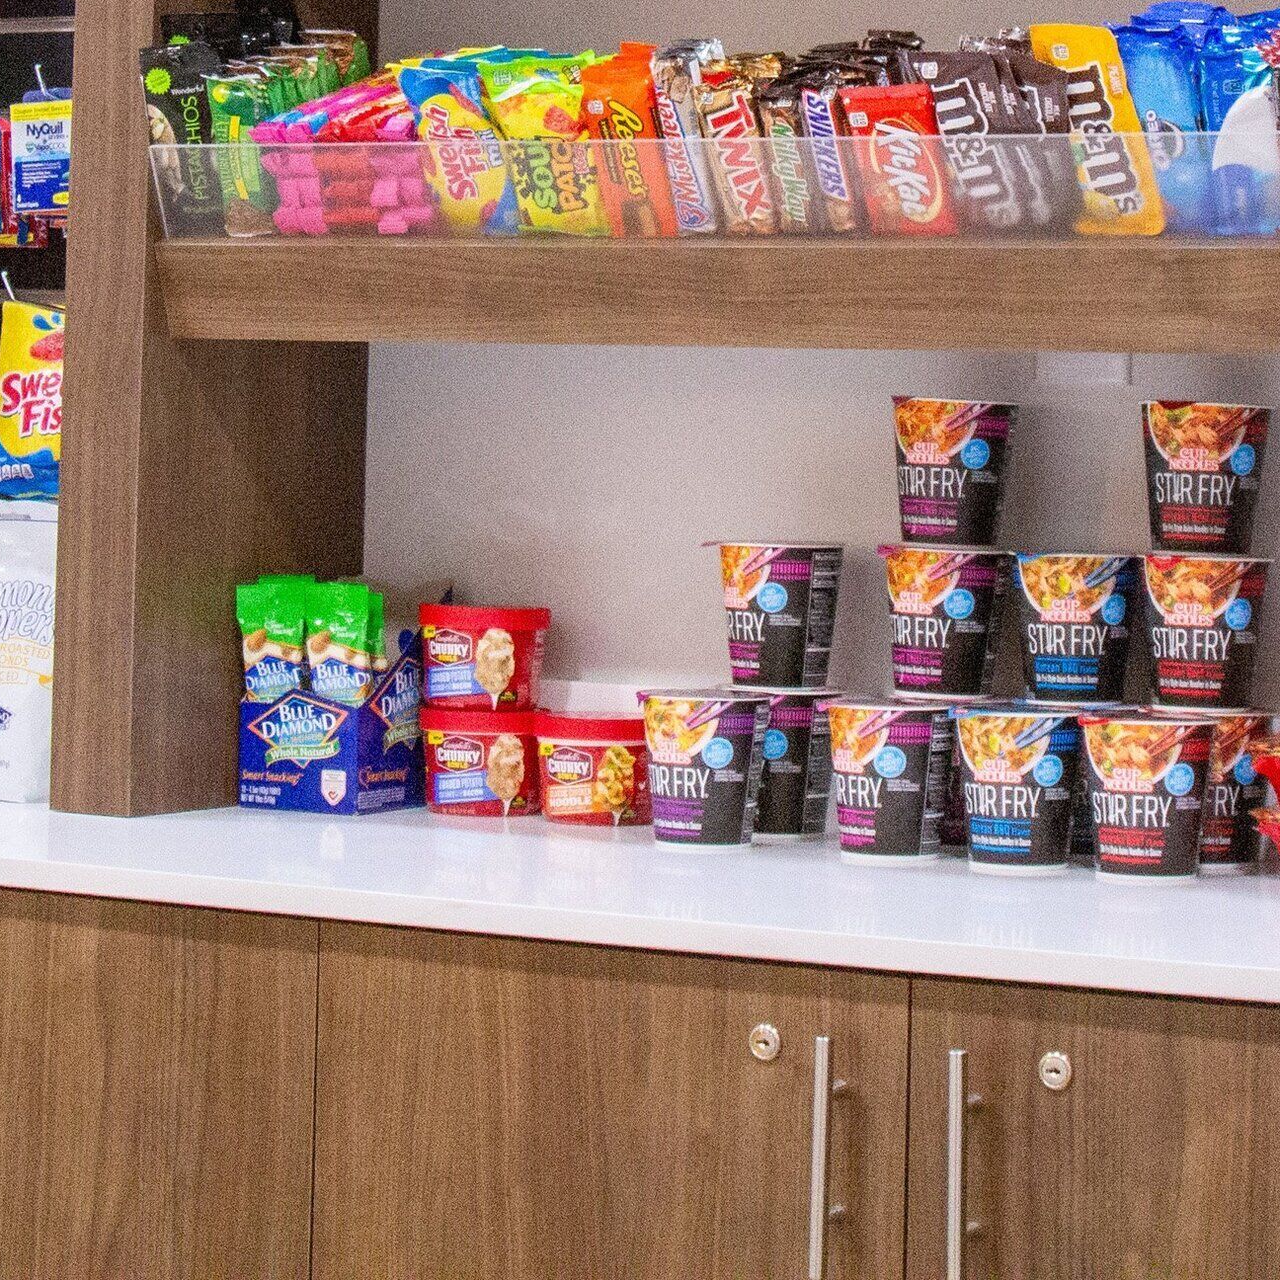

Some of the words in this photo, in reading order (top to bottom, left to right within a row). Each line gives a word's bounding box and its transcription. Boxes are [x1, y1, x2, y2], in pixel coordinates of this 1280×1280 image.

[26, 122, 63, 139] NyQuil
[609, 100, 648, 199] Reese's
[805, 92, 848, 200] SNICKERS
[708, 91, 771, 219] TWIX
[913, 441, 939, 454] CUP
[1180, 448, 1209, 460] CUP
[906, 453, 949, 465] NOODLES
[1169, 458, 1219, 471] NOODLES
[930, 468, 968, 499] FRY
[1155, 471, 1193, 504] STIR
[1198, 474, 1235, 506] FRY
[900, 591, 922, 602] CUP
[894, 602, 932, 614] NOODLES
[1052, 600, 1080, 612] CUP
[1174, 603, 1202, 616] CUP
[1040, 610, 1091, 622] NOODLES
[1164, 614, 1214, 626] NOODLES
[736, 612, 765, 641] FRY
[916, 618, 950, 648] FRY
[430, 641, 469, 655] CHUNKY
[1028, 624, 1065, 656] STIR
[1071, 626, 1108, 656] FRY
[1152, 627, 1188, 660] STIR
[1193, 630, 1232, 661] FRY
[0, 642, 50, 660] ROASTED
[256, 662, 287, 676] BLUE
[317, 664, 349, 678] BLUE
[279, 704, 315, 721] BLUE
[261, 714, 337, 739] DIAMOND
[271, 747, 300, 761] Whole
[301, 745, 335, 758] Natural
[438, 748, 480, 763] CHUNKY
[548, 759, 589, 775] CHUNKY
[983, 759, 1009, 771] CUP
[974, 770, 1023, 783] NOODLES
[1113, 768, 1141, 781] CUP
[673, 767, 710, 799] FRY
[1103, 779, 1154, 793] NOODLES
[849, 777, 882, 808] FRY
[965, 782, 997, 816] STIR
[1002, 786, 1040, 819] FRY
[1092, 791, 1127, 824] STIR
[1133, 796, 1171, 828] FRY
